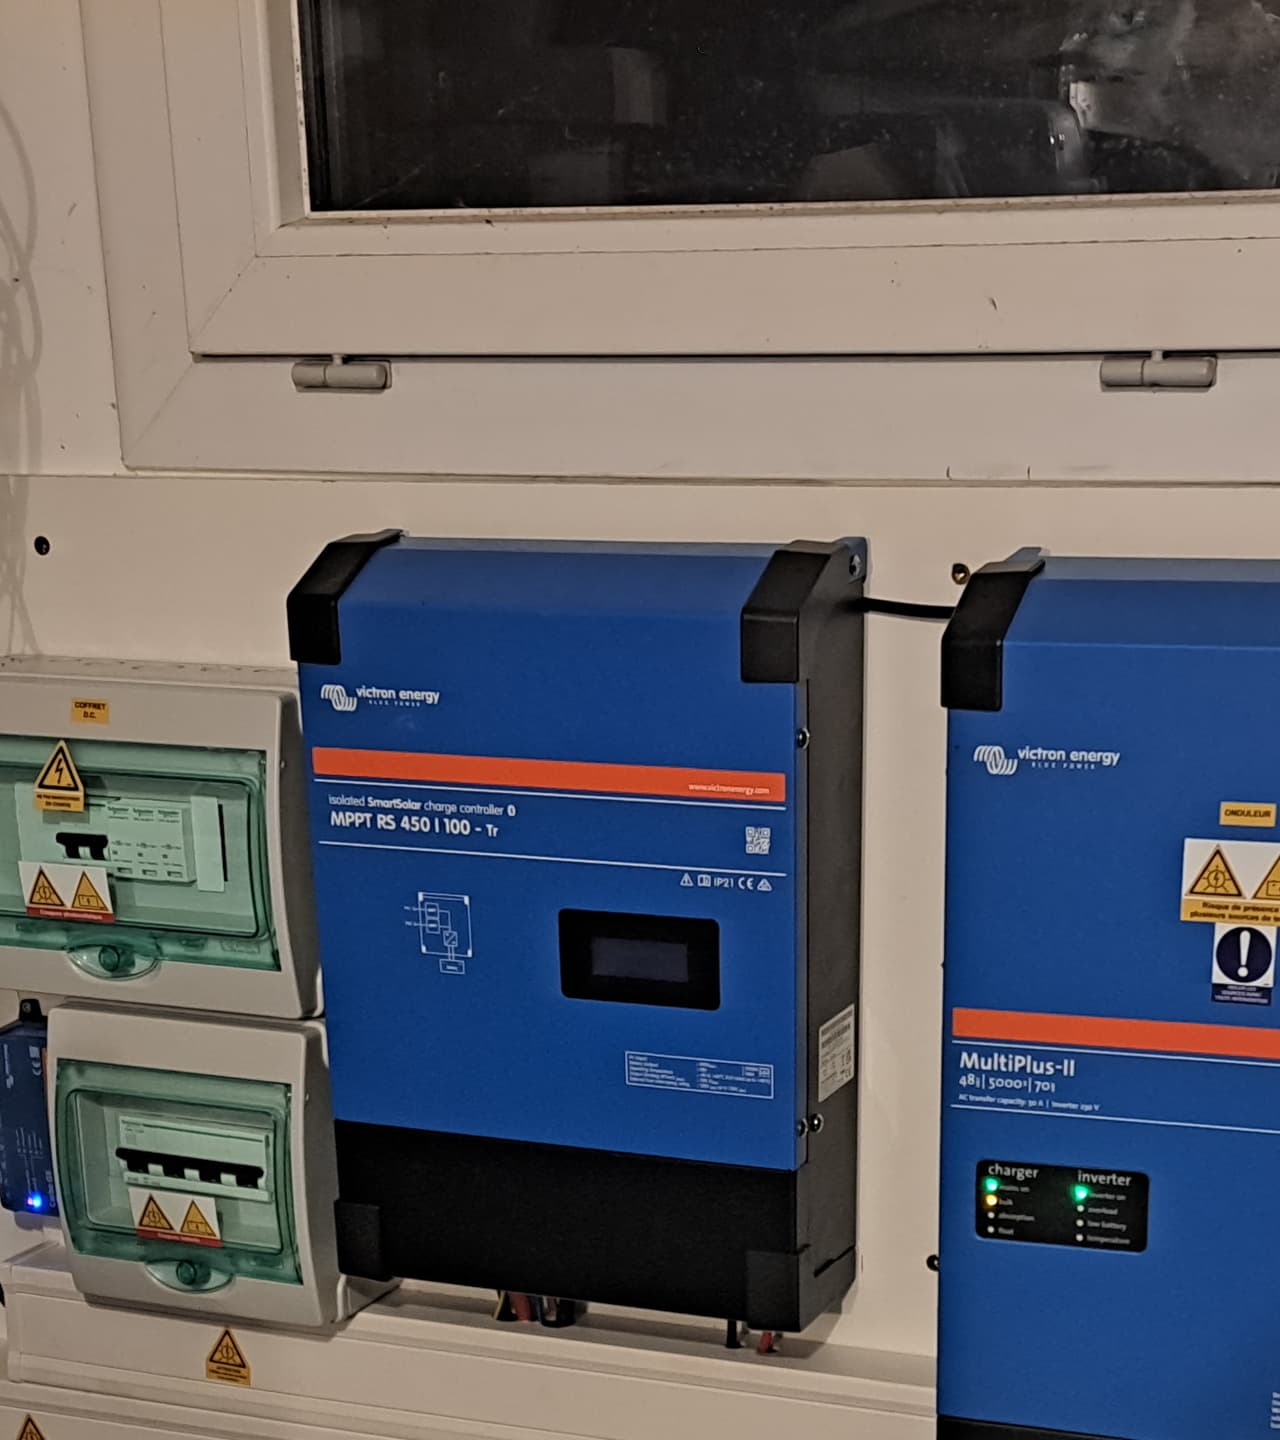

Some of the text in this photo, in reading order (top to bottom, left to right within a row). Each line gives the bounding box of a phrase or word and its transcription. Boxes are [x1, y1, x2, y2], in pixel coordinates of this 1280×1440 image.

[356, 684, 440, 704] victron energy
[74, 701, 106, 710] COFFRET
[1018, 745, 1120, 766] victron energy
[329, 794, 504, 816] isolated SmartSolar charge controller
[1224, 808, 1272, 818] ONDULEUR
[330, 811, 372, 828] MPPT
[376, 813, 396, 830] RS
[400, 815, 430, 833] 450
[443, 818, 470, 836] 100
[485, 824, 498, 837] Tr
[713, 877, 734, 888] IP21
[960, 1052, 1075, 1077] MultiPlus-II
[988, 1163, 1039, 1181] charger
[1078, 1170, 1132, 1186] inverter
[1088, 1207, 1118, 1215] overload
[1102, 1221, 1127, 1232] battery
